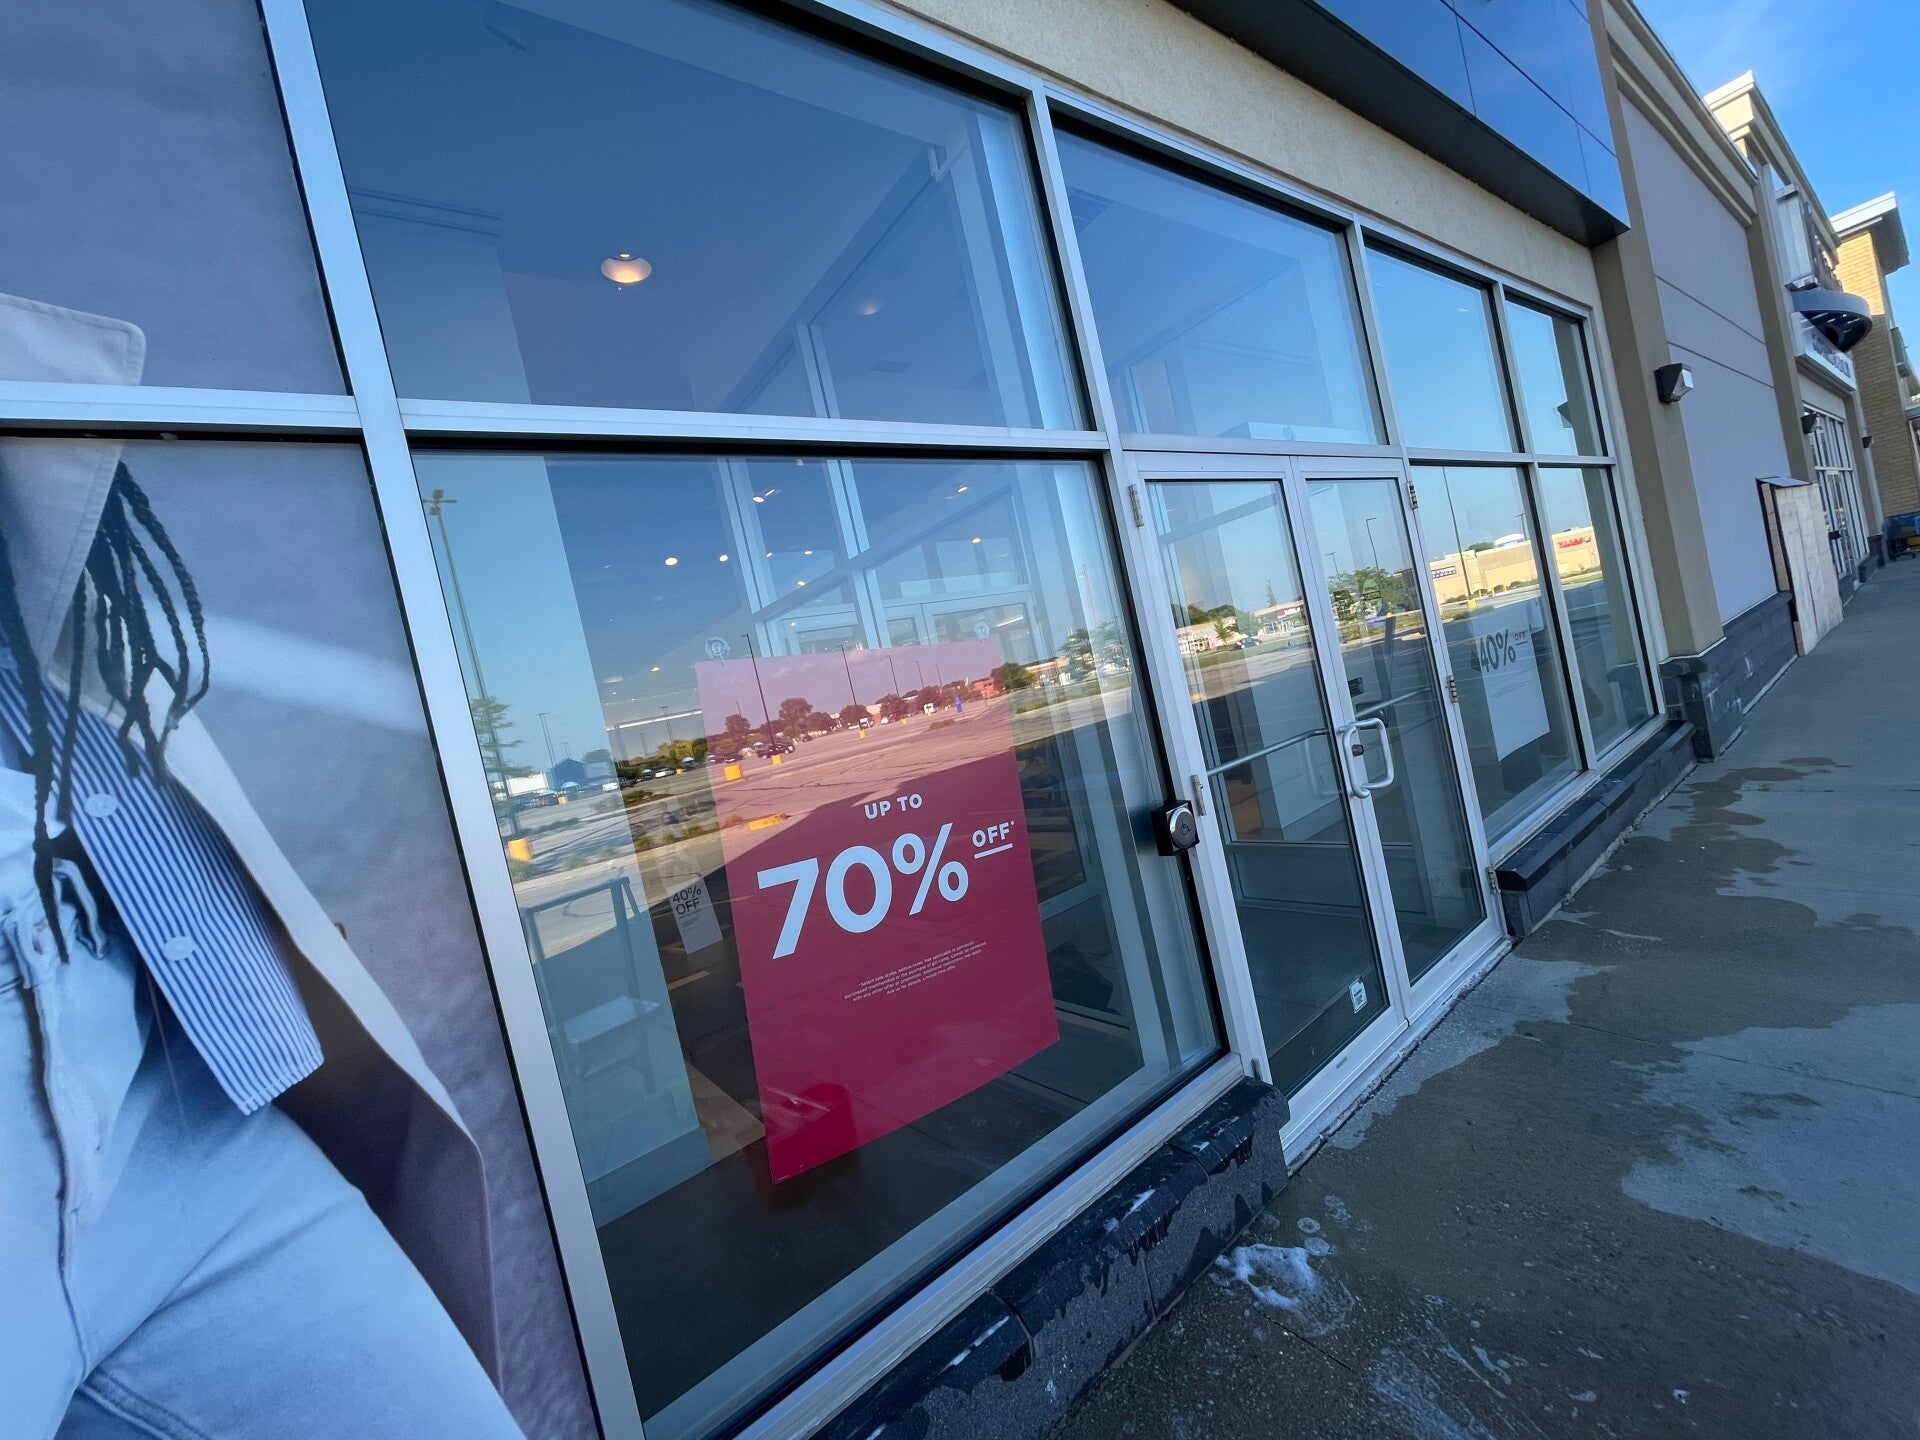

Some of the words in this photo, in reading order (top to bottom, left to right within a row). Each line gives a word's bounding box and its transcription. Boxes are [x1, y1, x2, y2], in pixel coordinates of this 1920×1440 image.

[1480, 629, 1516, 672] 40%
[865, 800, 891, 819] UP
[897, 793, 923, 812] TO
[672, 885, 702, 903] 40%
[757, 823, 969, 960] 70%
[675, 897, 701, 915] OFF
